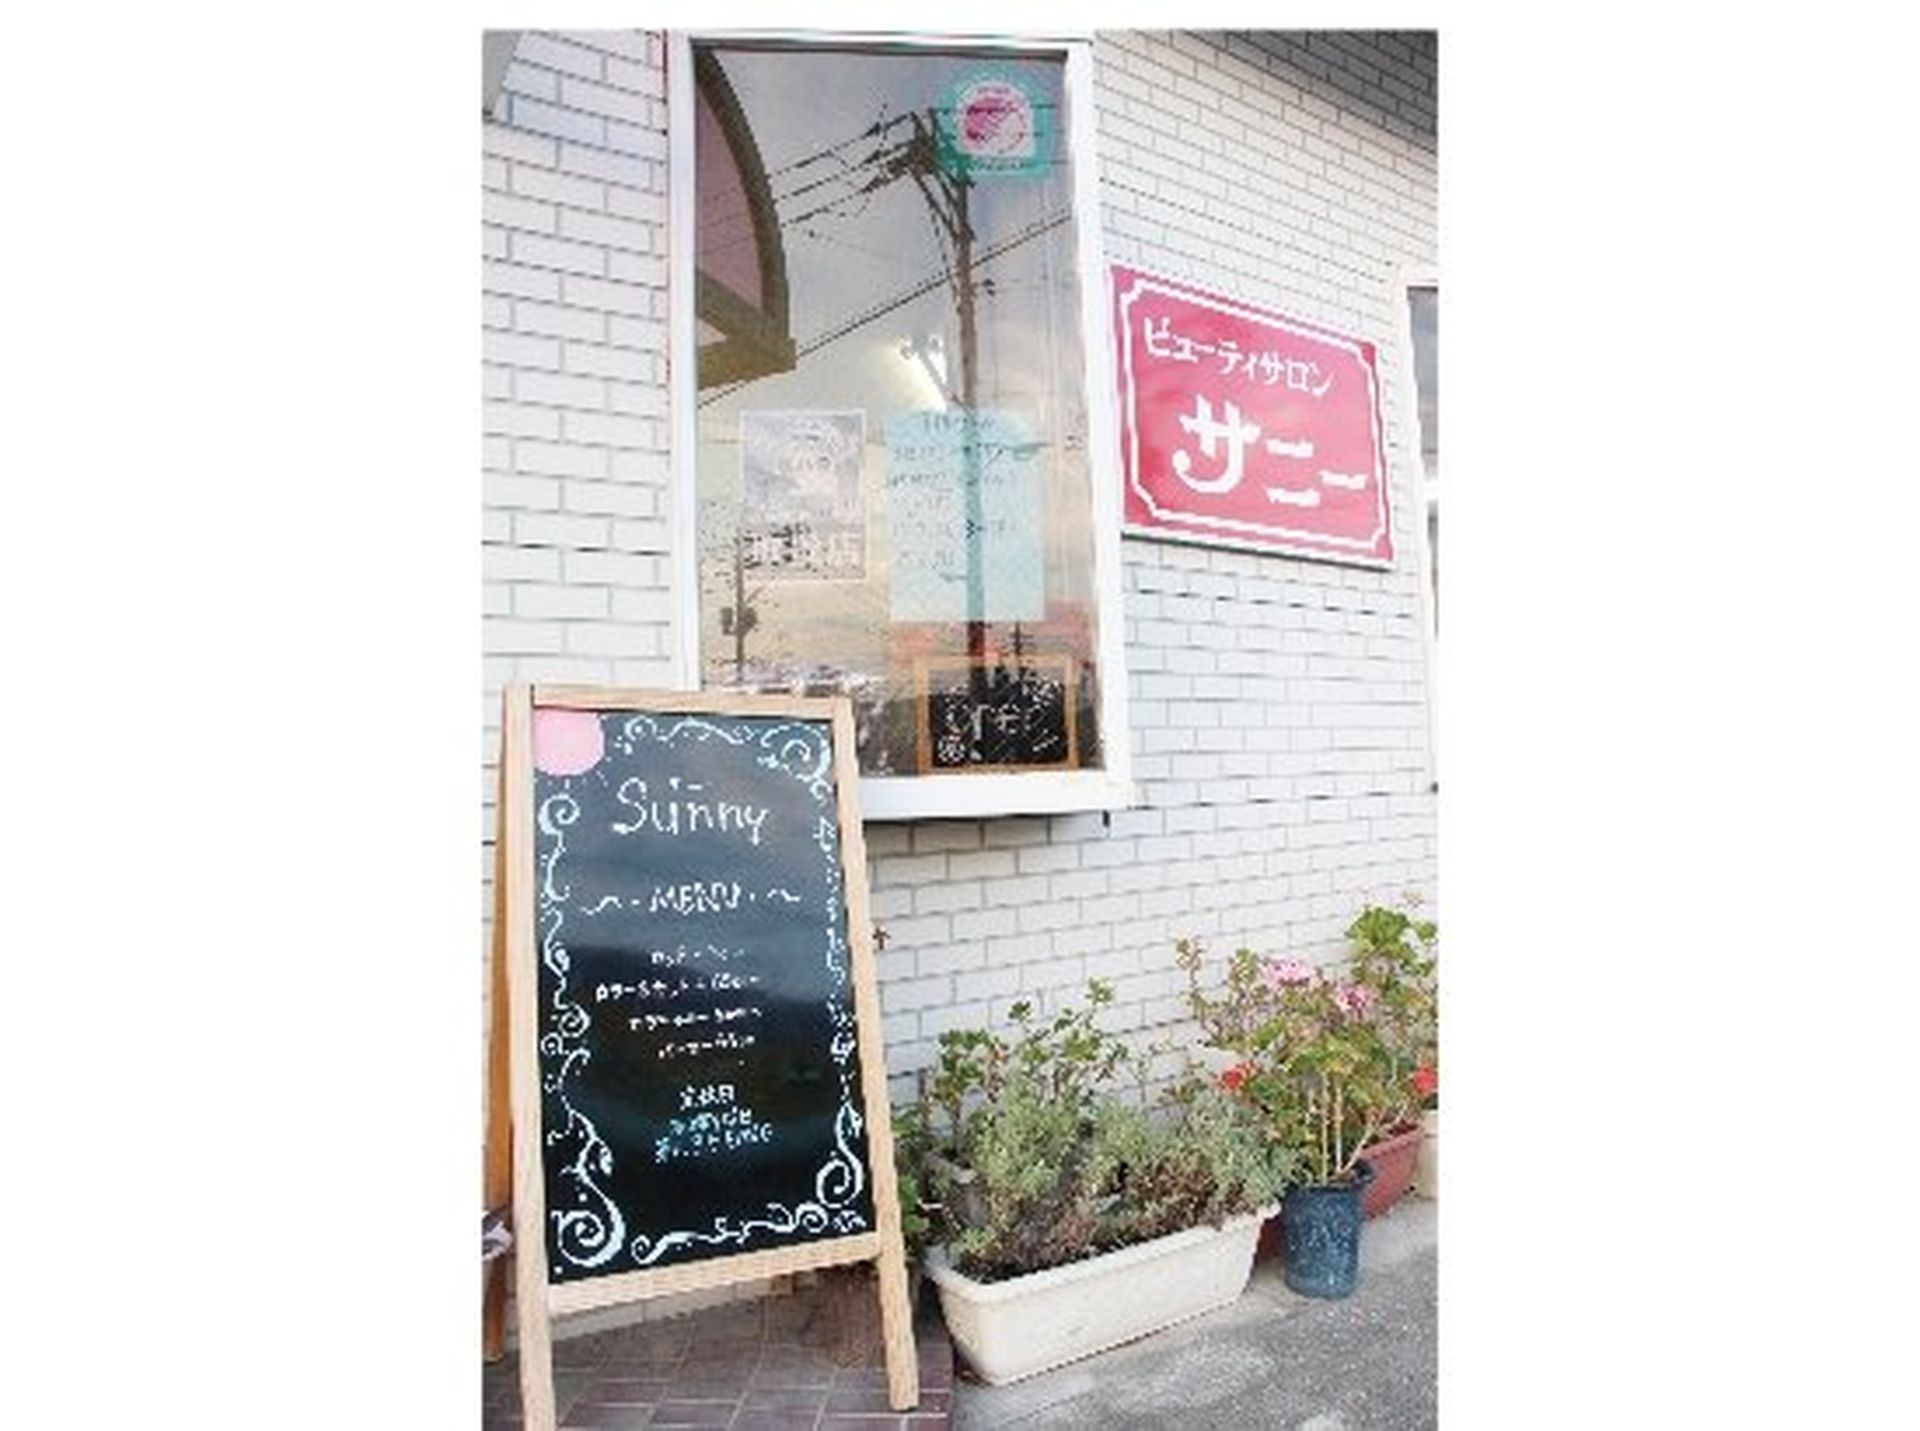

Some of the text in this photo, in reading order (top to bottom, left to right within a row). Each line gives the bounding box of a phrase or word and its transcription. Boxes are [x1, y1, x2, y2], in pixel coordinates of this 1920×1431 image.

[1143, 316, 1336, 398] ビューティサロン
[1171, 393, 1369, 507] サニー
[611, 776, 770, 847] Sunny
[648, 880, 743, 916] MENU
